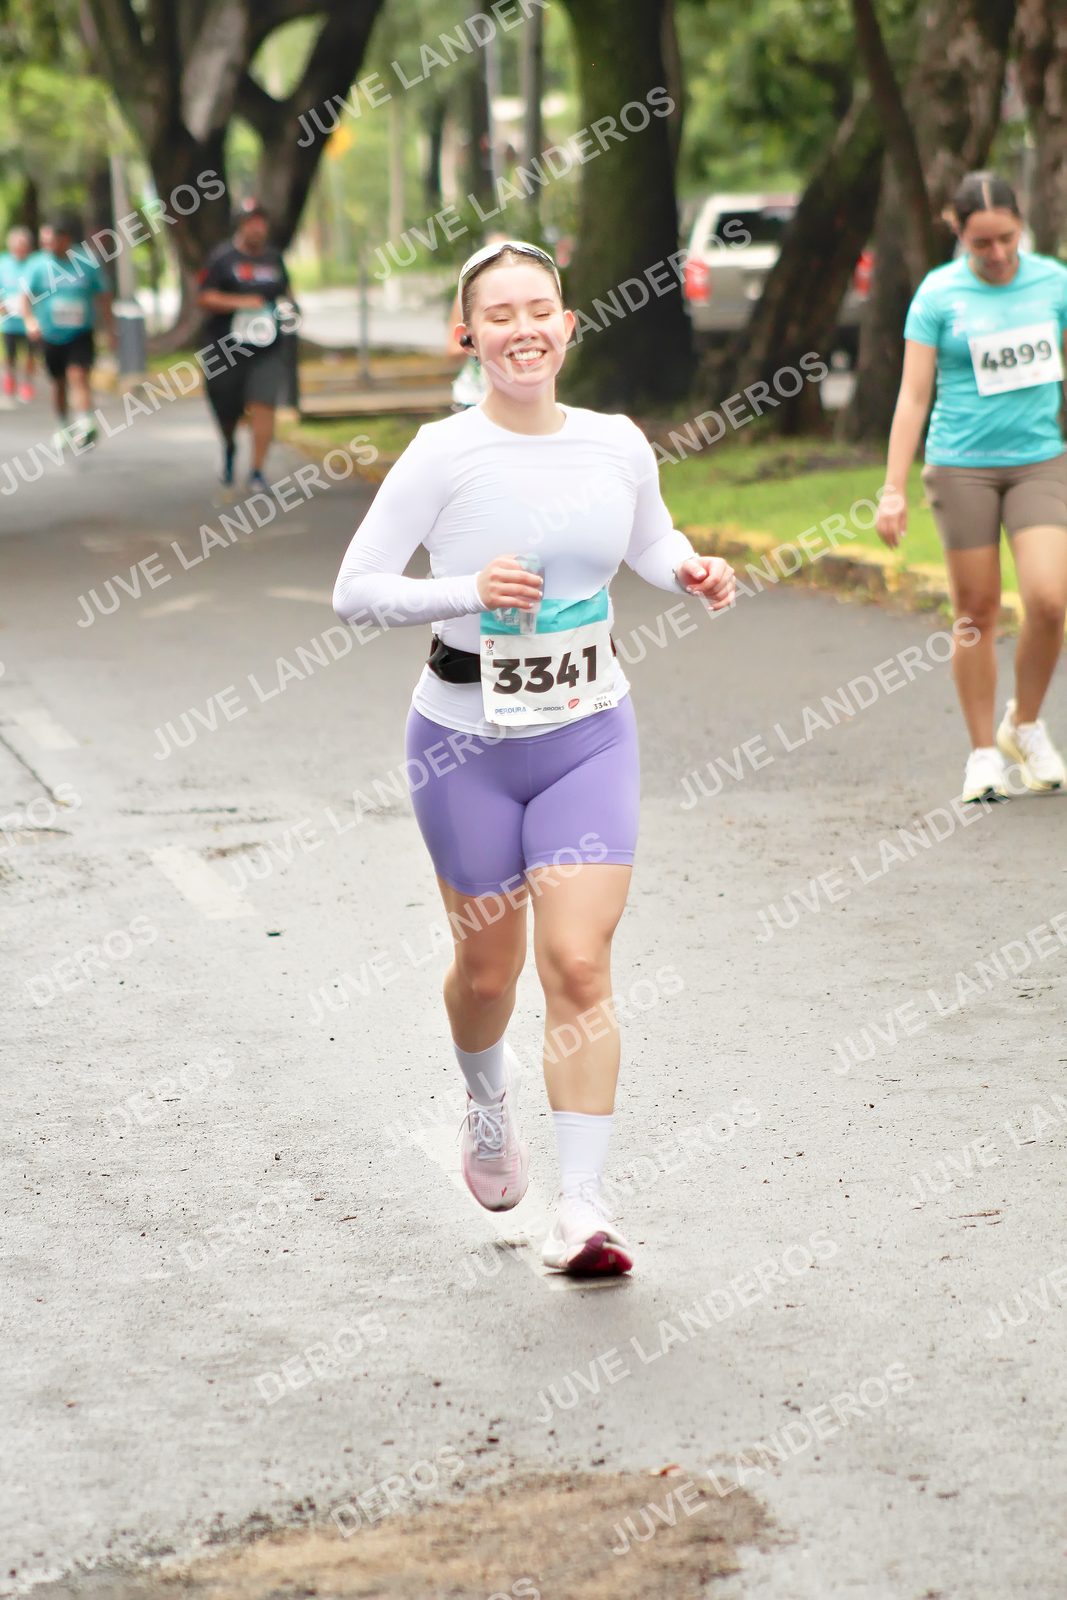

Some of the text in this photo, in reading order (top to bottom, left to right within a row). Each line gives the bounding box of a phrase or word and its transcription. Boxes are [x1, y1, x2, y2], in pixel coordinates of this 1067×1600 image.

[981, 340, 1052, 372] 4899
[492, 645, 597, 695] 3341
[593, 699, 612, 710] 3341
